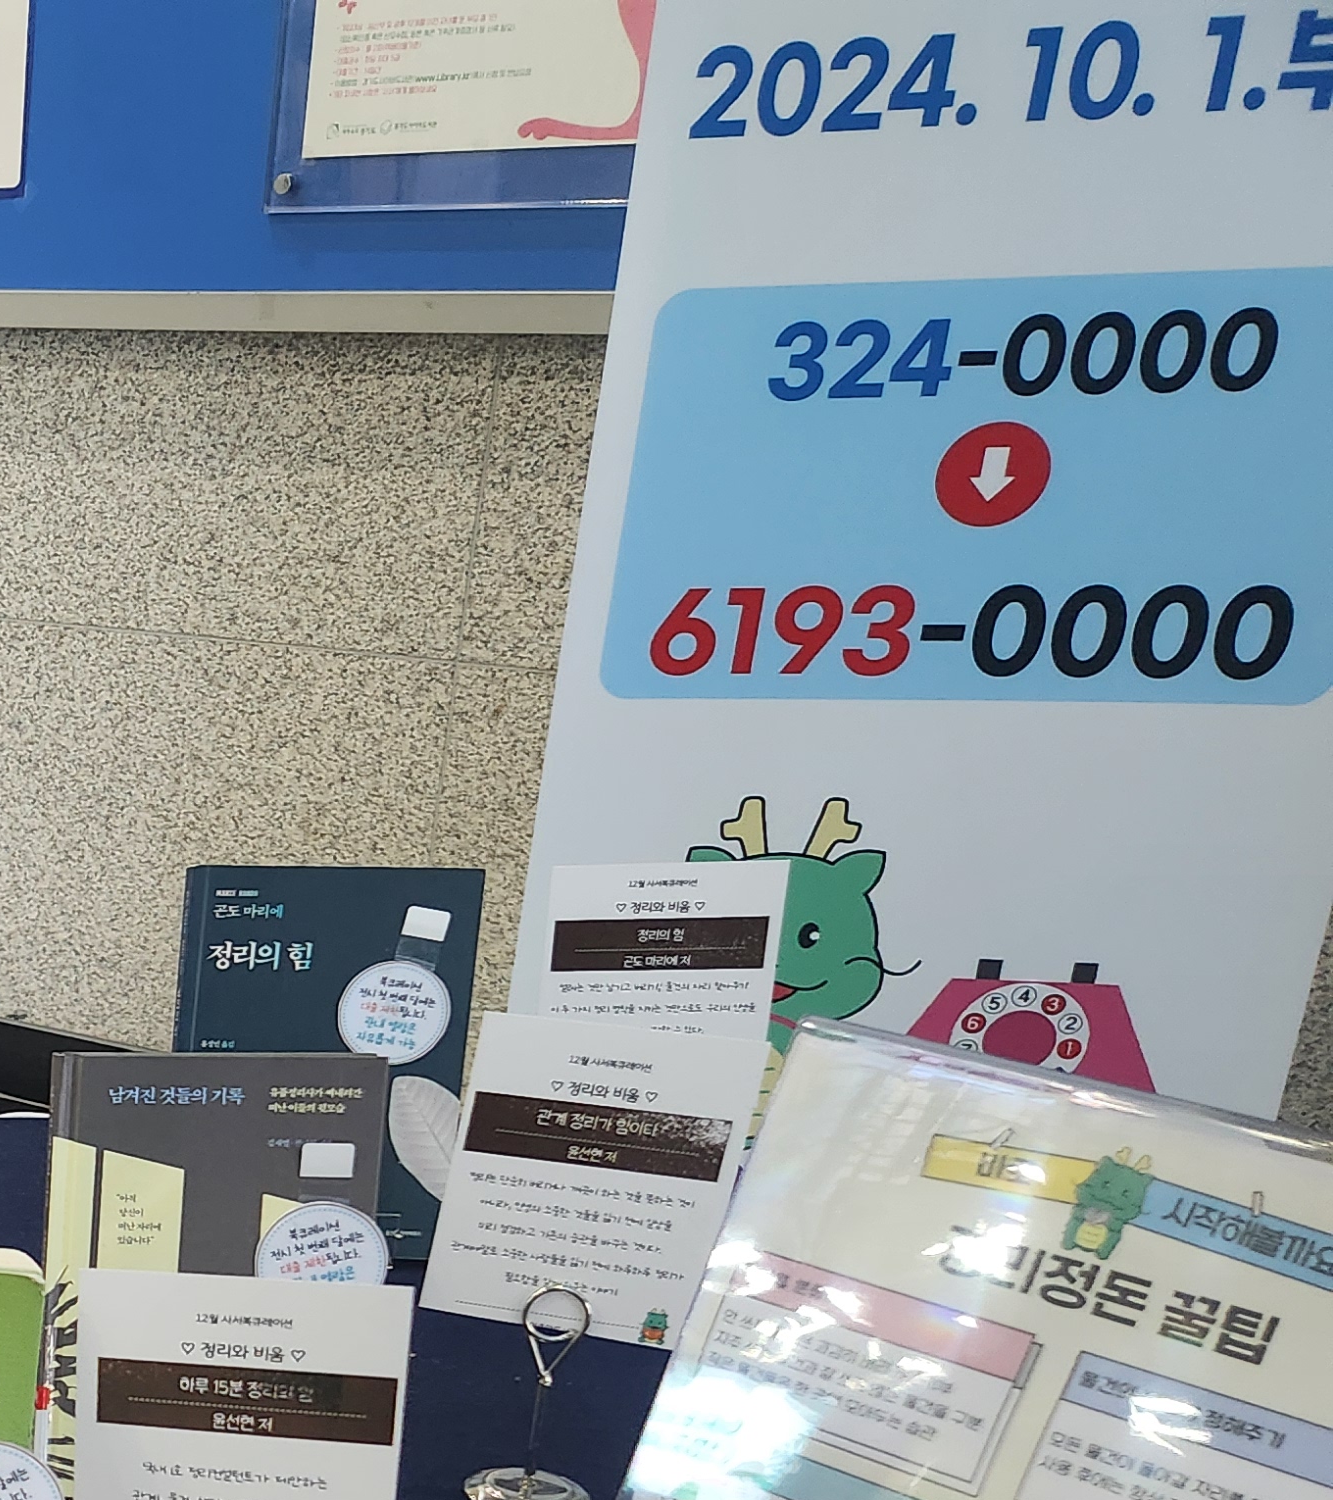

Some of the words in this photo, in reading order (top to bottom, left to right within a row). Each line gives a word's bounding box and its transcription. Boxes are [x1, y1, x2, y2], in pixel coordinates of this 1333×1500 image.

[689, 33, 977, 139] 2024.
[1025, 20, 1156, 122] 10.
[767, 307, 1279, 402] 324-0000
[649, 584, 1294, 679] 6193-0000
[213, 903, 240, 920] 곤도
[243, 903, 283, 920] 마리에
[207, 941, 281, 972] 정리의
[287, 942, 314, 970] 힘
[967, 1017, 979, 1031] 6
[988, 997, 1001, 1010] 5
[1018, 989, 1031, 1003] 4
[1047, 997, 1060, 1011] 3
[1064, 1017, 1077, 1030] 2
[109, 1087, 156, 1105] 남겨진
[160, 1087, 207, 1105] 것들의
[211, 1087, 245, 1106] 기록
[940, 1225, 1153, 1327] 리정돈
[1157, 1290, 1280, 1365] 꿀팁
